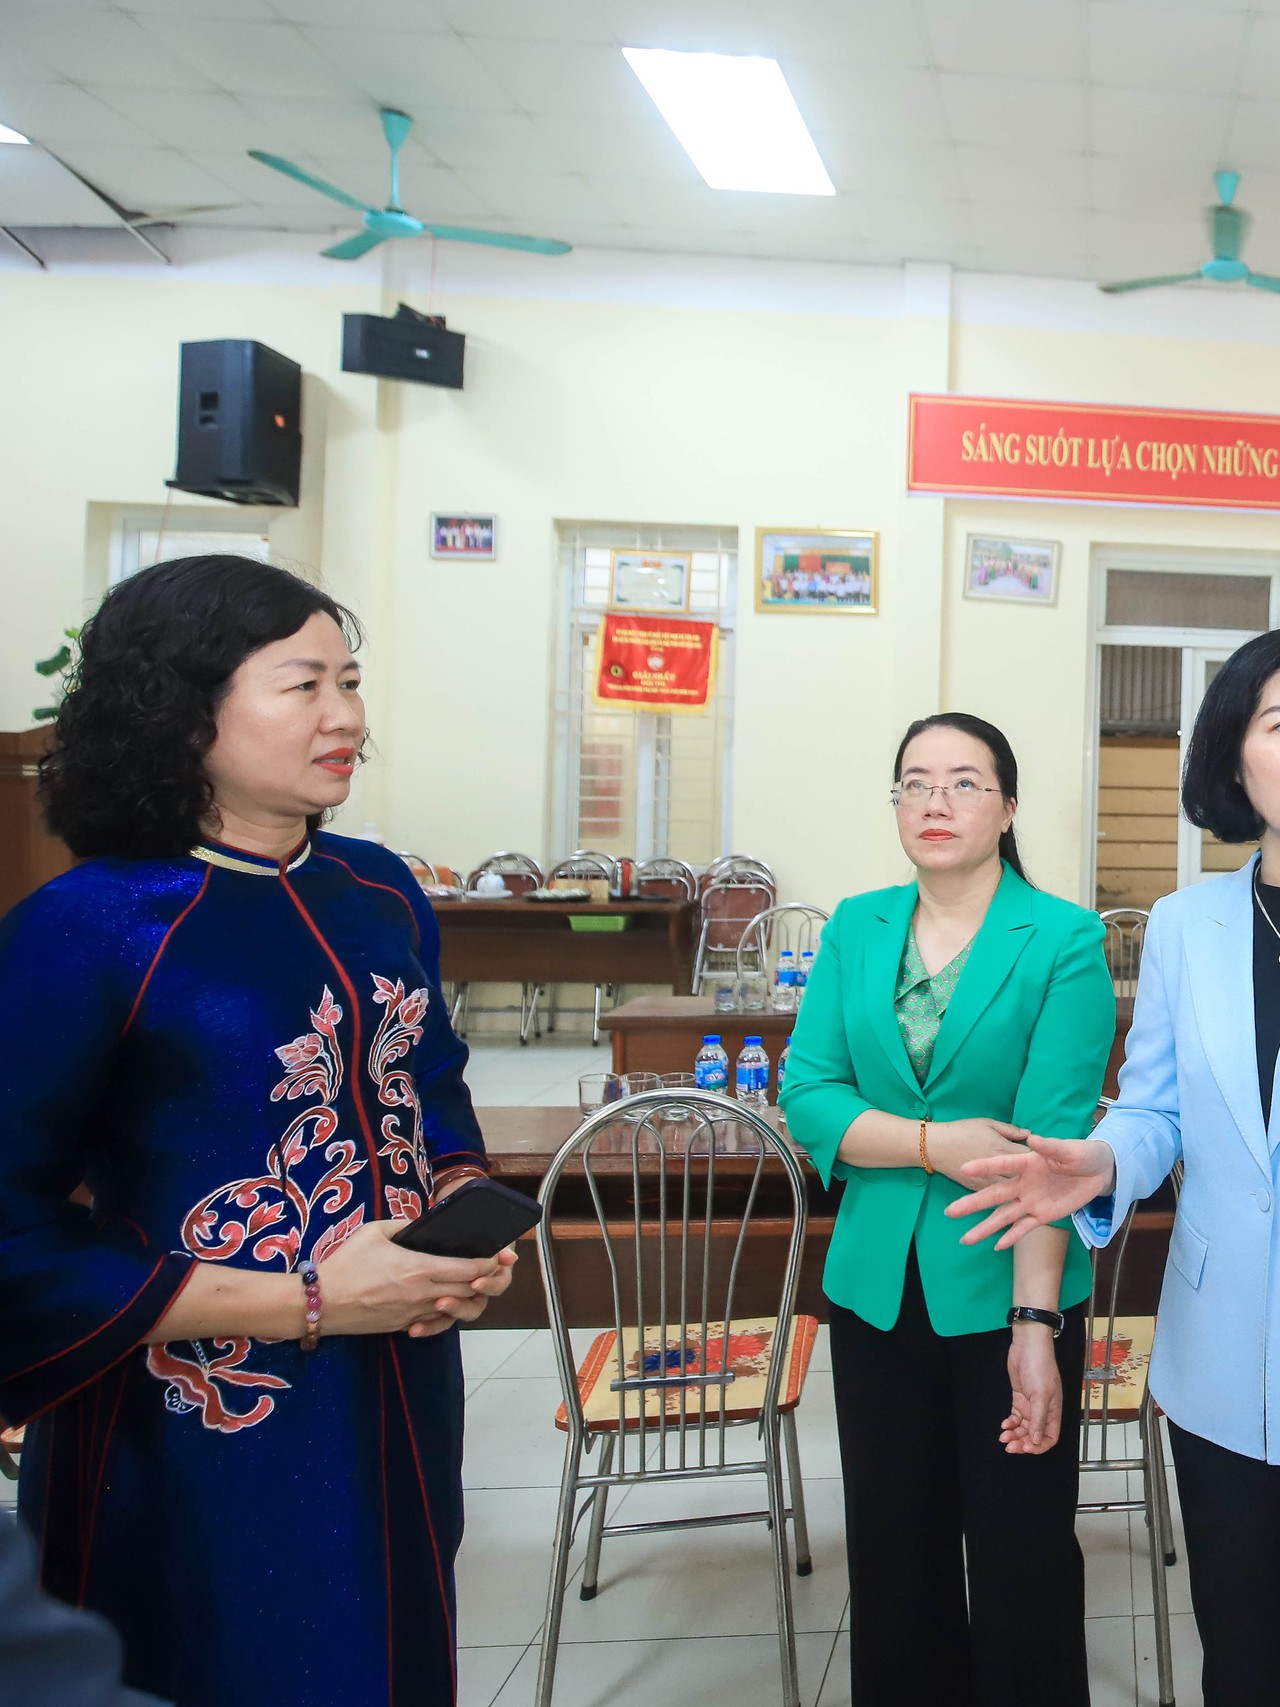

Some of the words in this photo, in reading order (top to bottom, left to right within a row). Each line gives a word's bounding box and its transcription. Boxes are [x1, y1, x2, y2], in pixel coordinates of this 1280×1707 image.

[961, 422, 1021, 464] SÁNG
[1025, 427, 1082, 467] SUỐT
[1087, 435, 1132, 477] LỰA
[1136, 441, 1197, 480] CHỌN
[1202, 440, 1279, 478] NHỮNG
